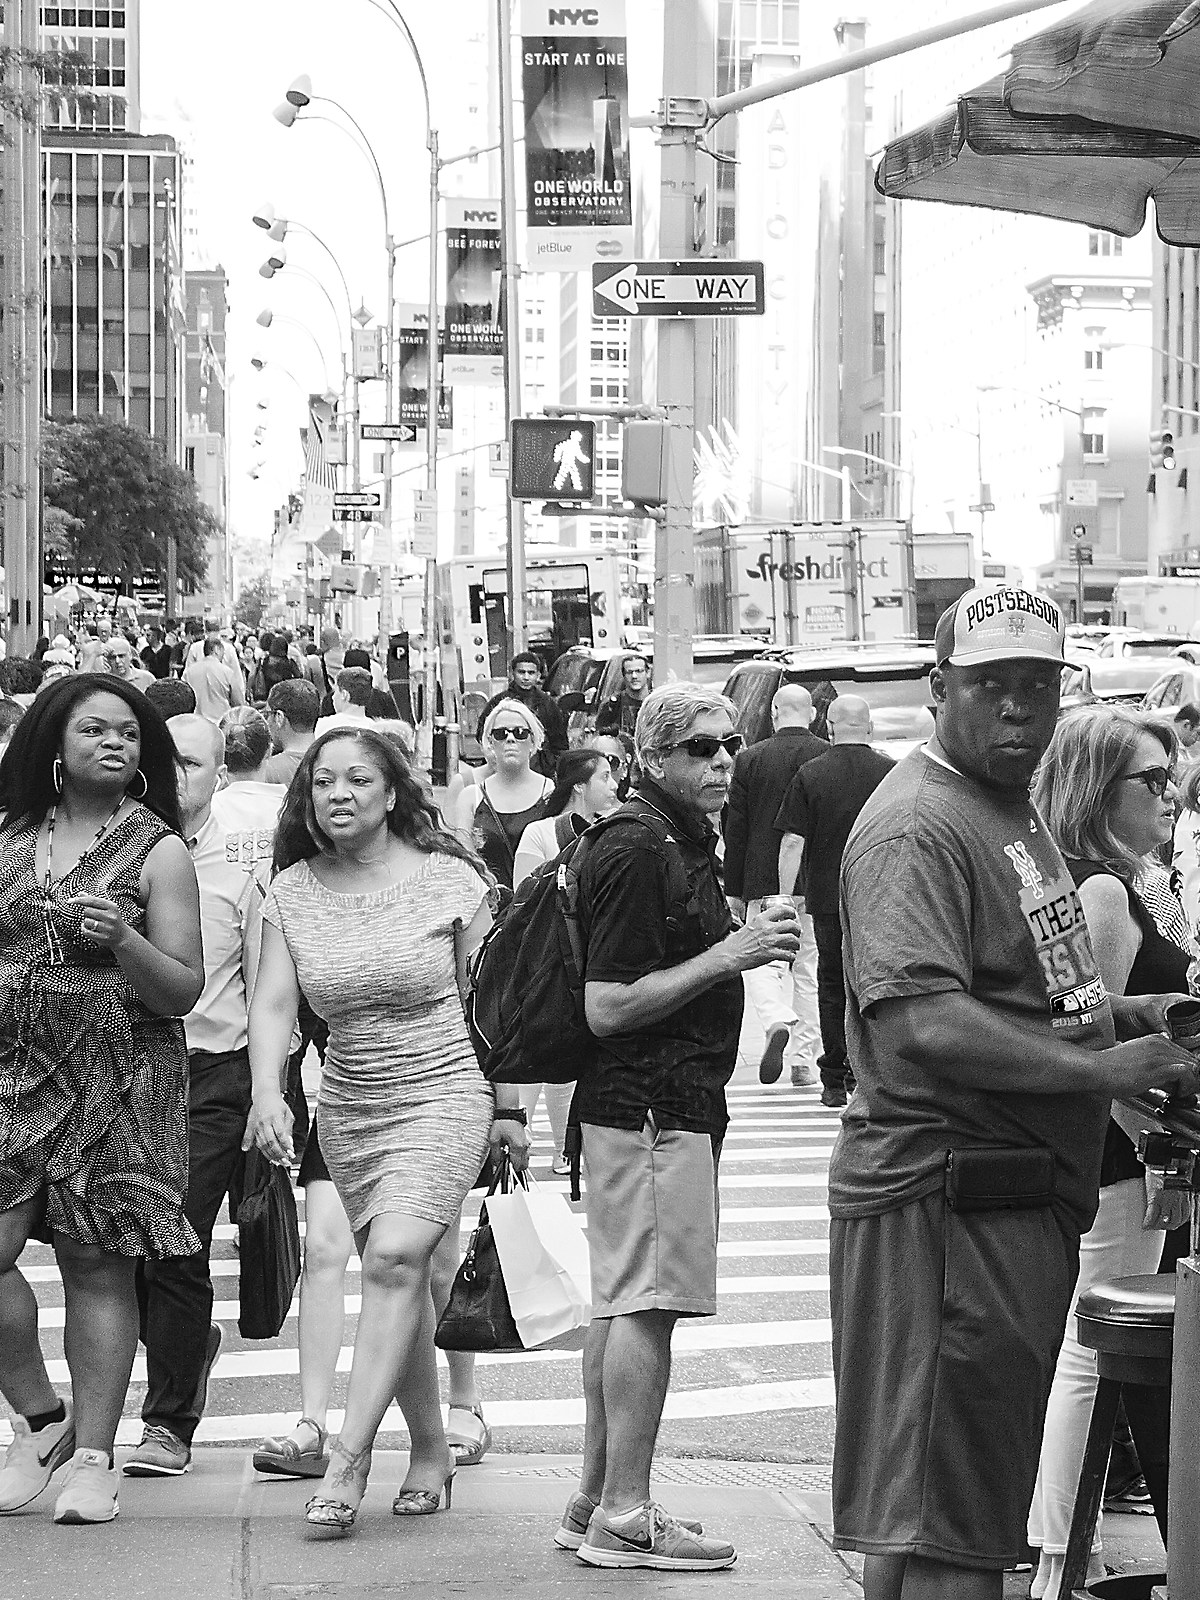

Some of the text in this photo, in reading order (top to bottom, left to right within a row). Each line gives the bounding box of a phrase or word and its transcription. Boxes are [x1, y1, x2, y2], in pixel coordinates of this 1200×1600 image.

[548, 9, 599, 25] NYC
[524, 53, 625, 66] START AT ONE
[534, 196, 623, 206] OBSERVATORY
[464, 210, 498, 223] NYC
[469, 239, 501, 249] FOREV
[537, 243, 572, 254] jetBlue
[616, 279, 749, 299] ONE WAY
[472, 323, 504, 334] WORL
[400, 336, 424, 344] START
[450, 335, 504, 344] OBSERVATOR
[966, 590, 1060, 633] POSTSEASON
